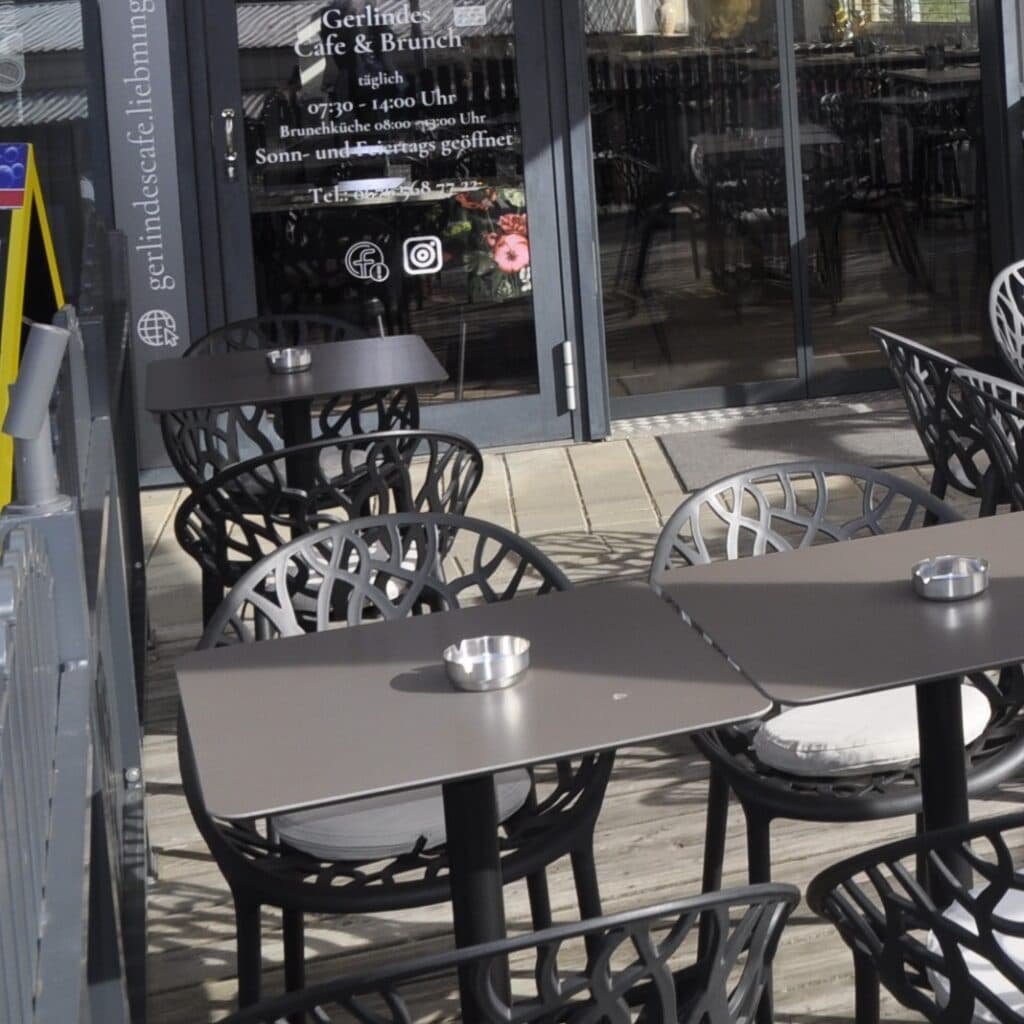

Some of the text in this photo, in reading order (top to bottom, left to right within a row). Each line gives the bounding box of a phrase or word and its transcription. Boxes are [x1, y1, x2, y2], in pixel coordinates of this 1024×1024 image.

[322, 3, 432, 29] Gerlindes
[294, 27, 463, 57] Cafe & Brunch
[358, 70, 404, 90] täglich
[308, 100, 353, 119] 07:30
[372, 96, 415, 113] 14:00
[420, 87, 457, 107] Uhr
[280, 119, 371, 138] Brunchküche
[374, 119, 411, 131] 08:00
[460, 111, 487, 125] Uhr
[255, 147, 310, 165] Sonn-
[315, 140, 350, 160] und
[441, 129, 514, 157] geöffnet
